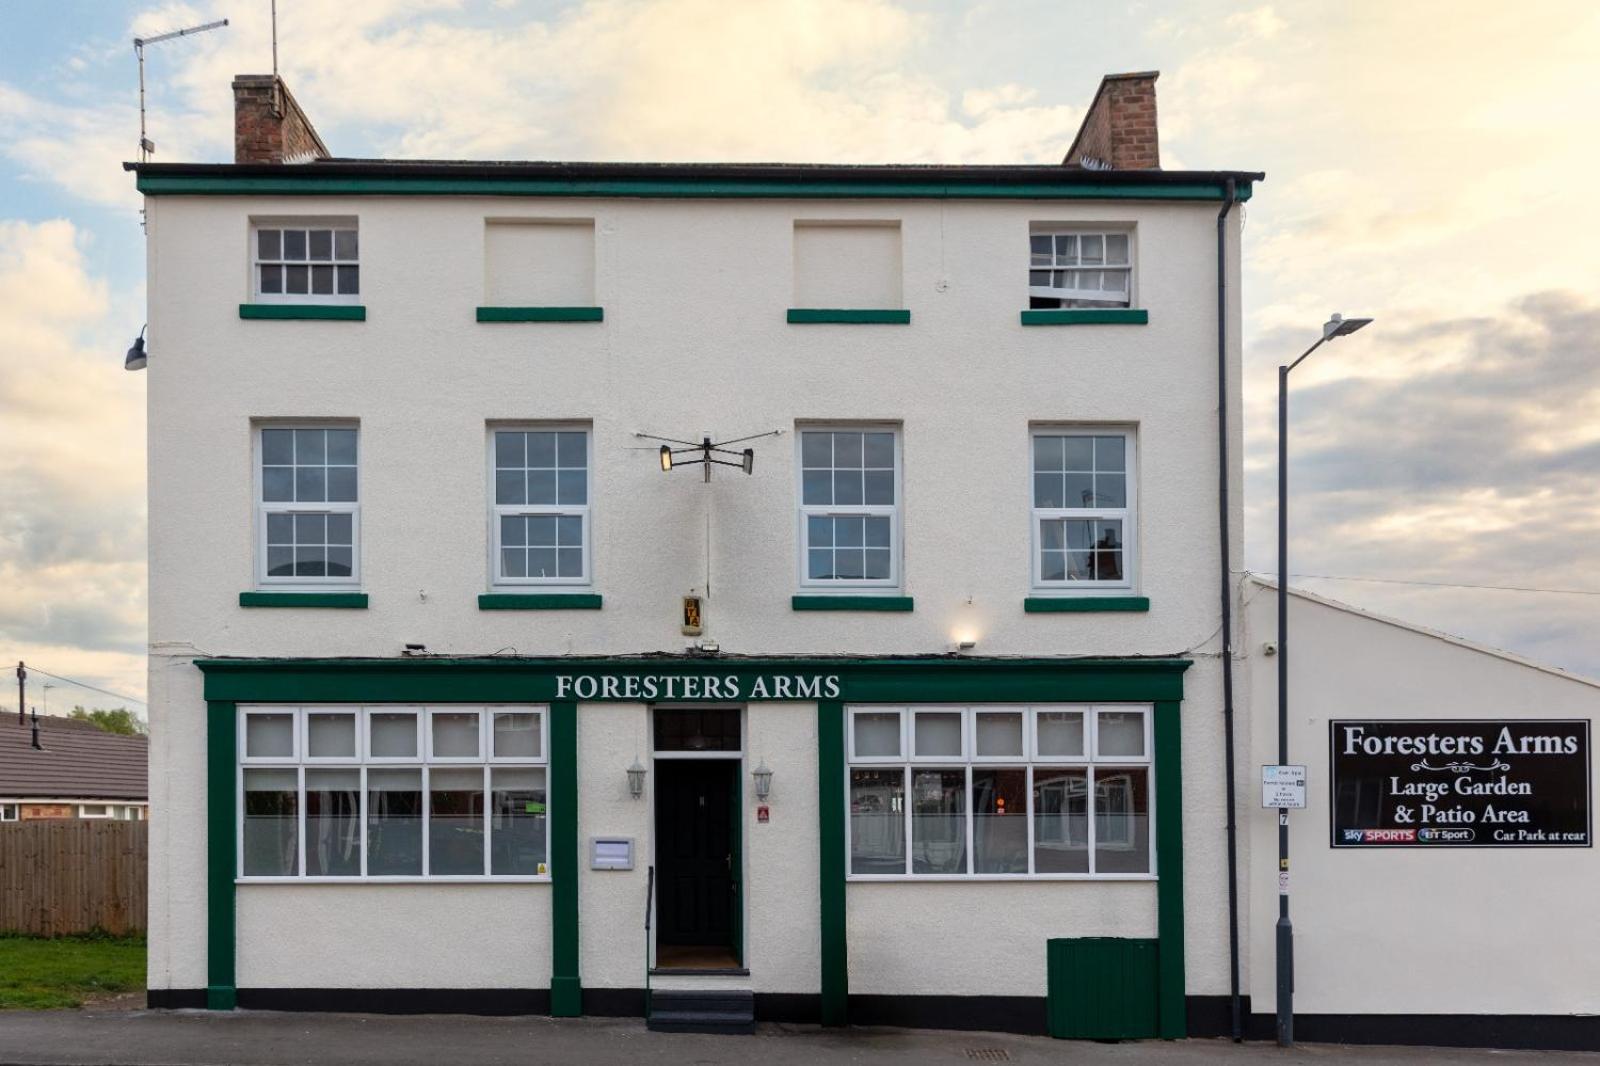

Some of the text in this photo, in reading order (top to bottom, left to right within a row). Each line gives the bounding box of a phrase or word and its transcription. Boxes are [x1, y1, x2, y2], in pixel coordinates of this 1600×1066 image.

[556, 676, 840, 699] FORESTERS ARMS
[1343, 726, 1578, 755] Foresters Arms
[1389, 776, 1533, 802] Large Garden
[1394, 804, 1530, 823] & Patio Area
[1344, 829, 1415, 842] sky SPORTS
[1425, 830, 1469, 841] BT Sport
[1493, 829, 1586, 841] Car Park at rear
